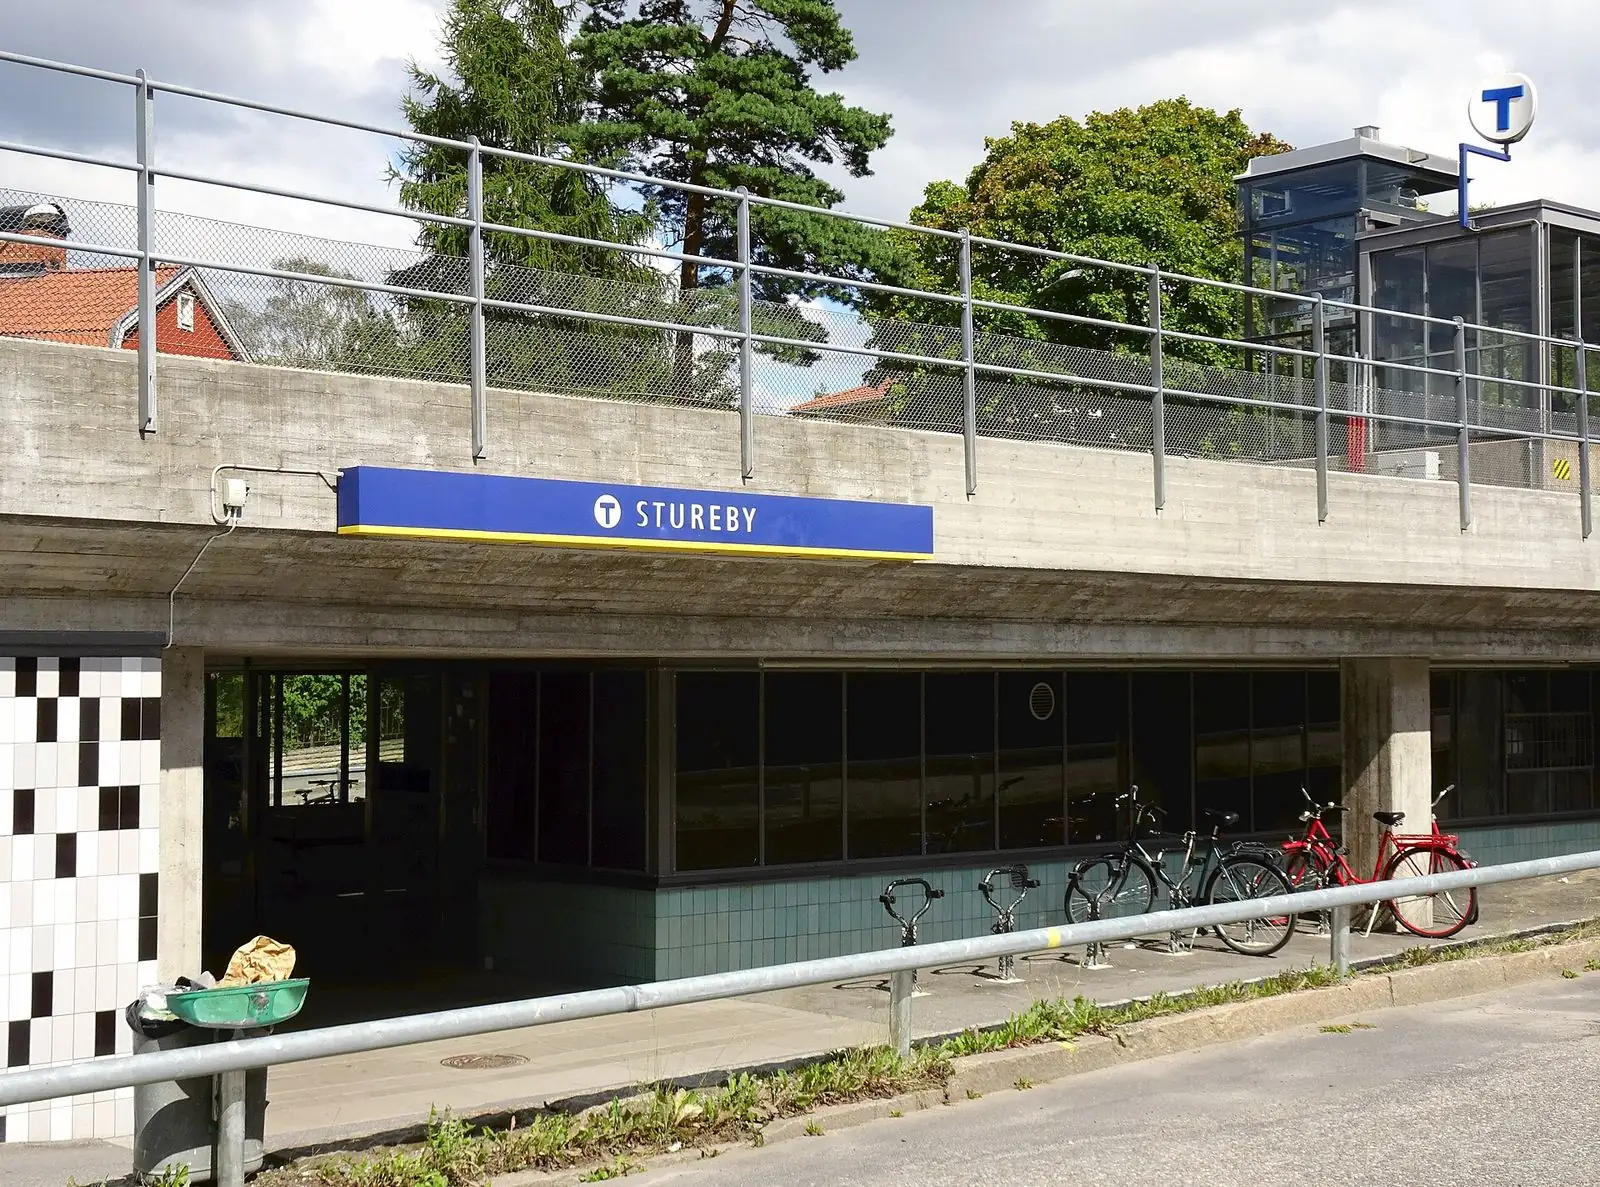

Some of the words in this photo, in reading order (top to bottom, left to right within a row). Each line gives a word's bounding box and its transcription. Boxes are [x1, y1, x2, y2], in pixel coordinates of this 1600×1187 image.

[1482, 86, 1524, 131] T
[600, 502, 615, 525] T
[636, 500, 757, 533] STUREBY
